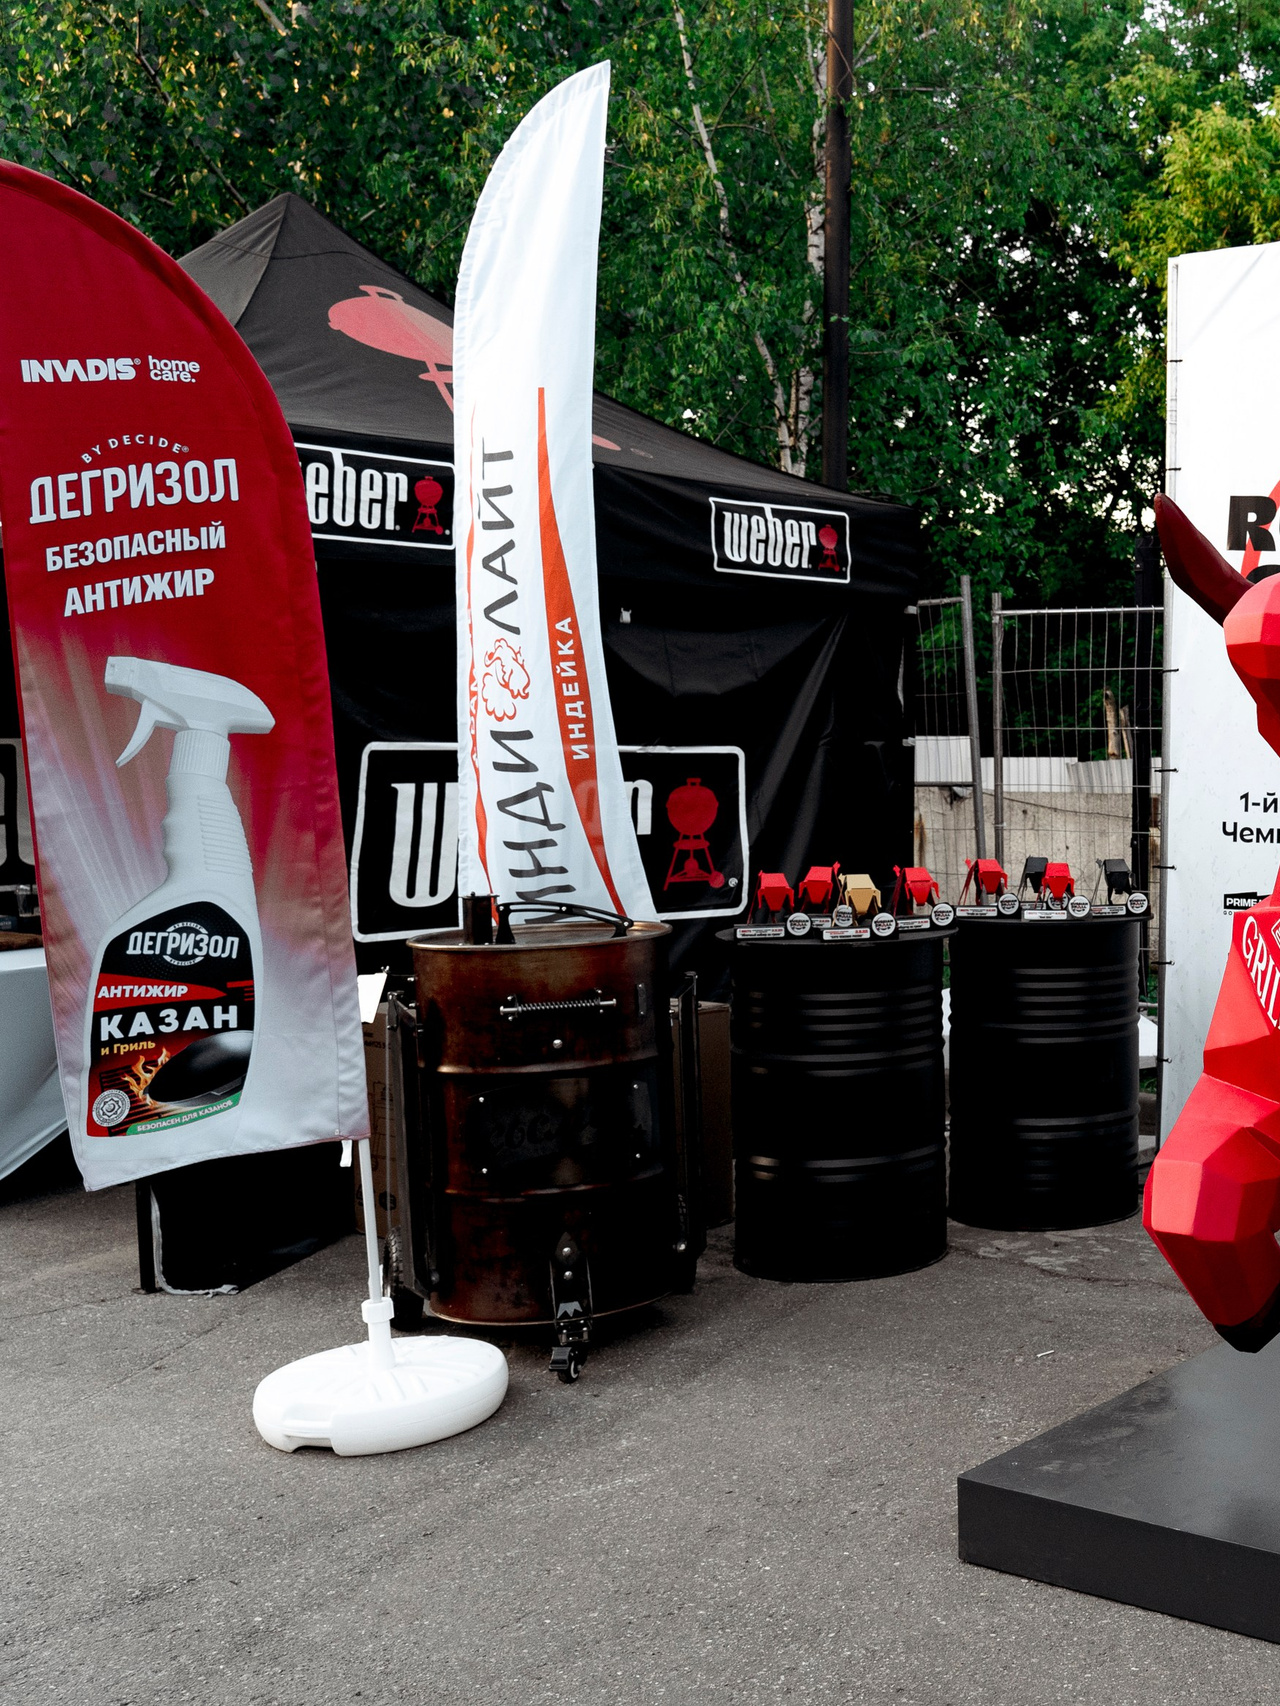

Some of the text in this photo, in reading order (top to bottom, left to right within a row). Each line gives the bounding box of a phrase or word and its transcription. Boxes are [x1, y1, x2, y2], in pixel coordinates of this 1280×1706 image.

[148, 355, 200, 373] home
[150, 367, 196, 383] care.
[81, 444, 103, 465] BY
[29, 458, 239, 525] ДЕГРИЗОЛ
[299, 450, 408, 531] eber
[46, 520, 226, 572] БЕЗОПАСНЫЙ
[722, 505, 817, 569] weber
[64, 568, 215, 617] АНТИЖИР
[555, 616, 591, 761] ИНДЕЙКА
[1239, 792, 1279, 813] 1-й
[1226, 897, 1263, 907] PRIME
[126, 931, 239, 959] ДЕГРИЗОЛ
[97, 985, 188, 998] АНТИЖИР
[100, 1005, 238, 1041] КАЗАН
[101, 1040, 156, 1056] и Гриль
[137, 1100, 233, 1131] БЕЗОПАСЕН ДЛЯ КАЗАНОВ
